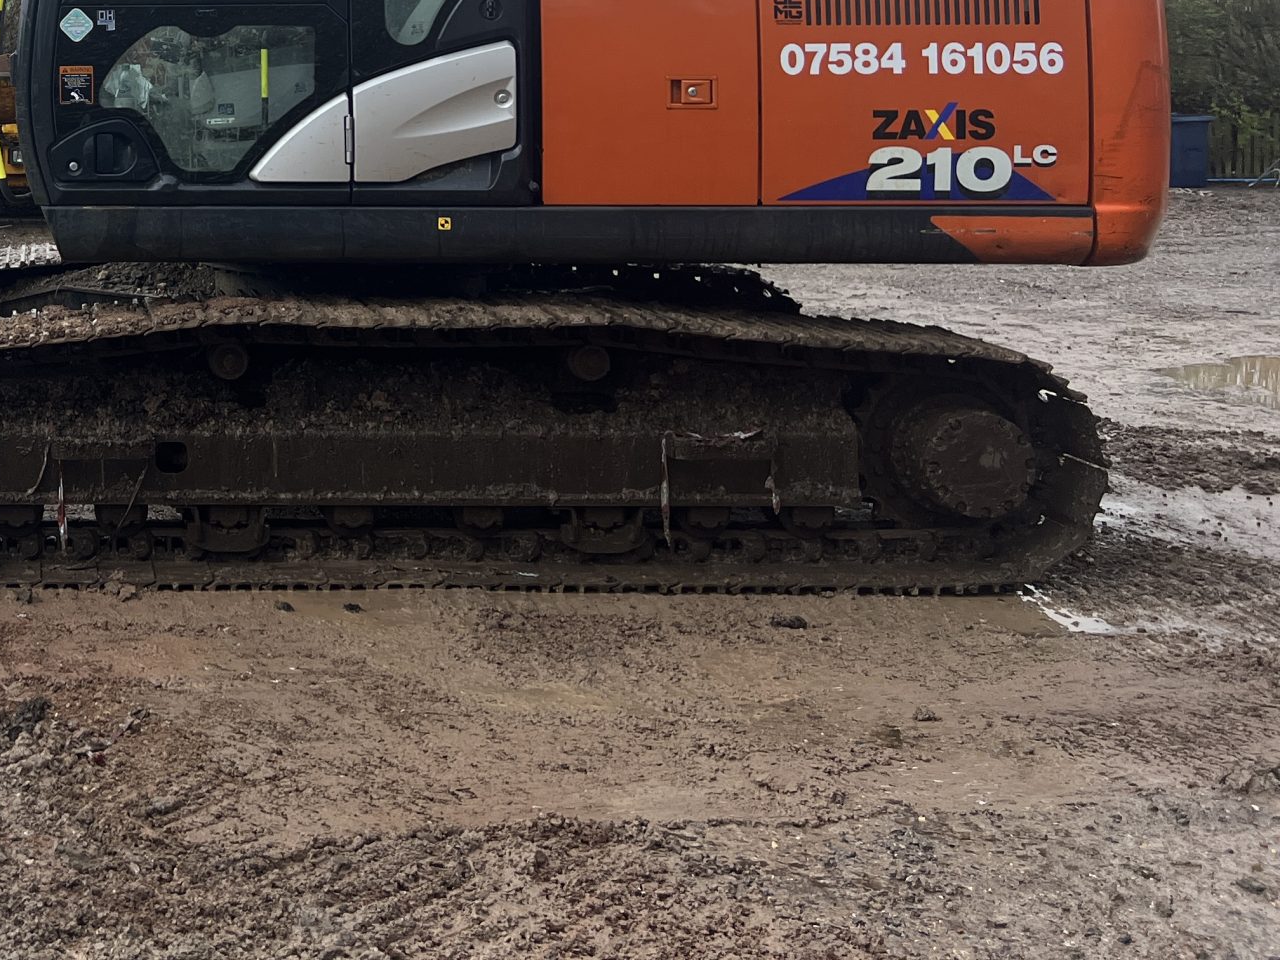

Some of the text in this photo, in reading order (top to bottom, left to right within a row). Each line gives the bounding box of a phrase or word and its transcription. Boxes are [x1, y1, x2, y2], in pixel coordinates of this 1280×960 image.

[780, 42, 1064, 75] 07584 161056
[872, 101, 996, 140] ZAXIS
[866, 145, 1013, 195] 210
